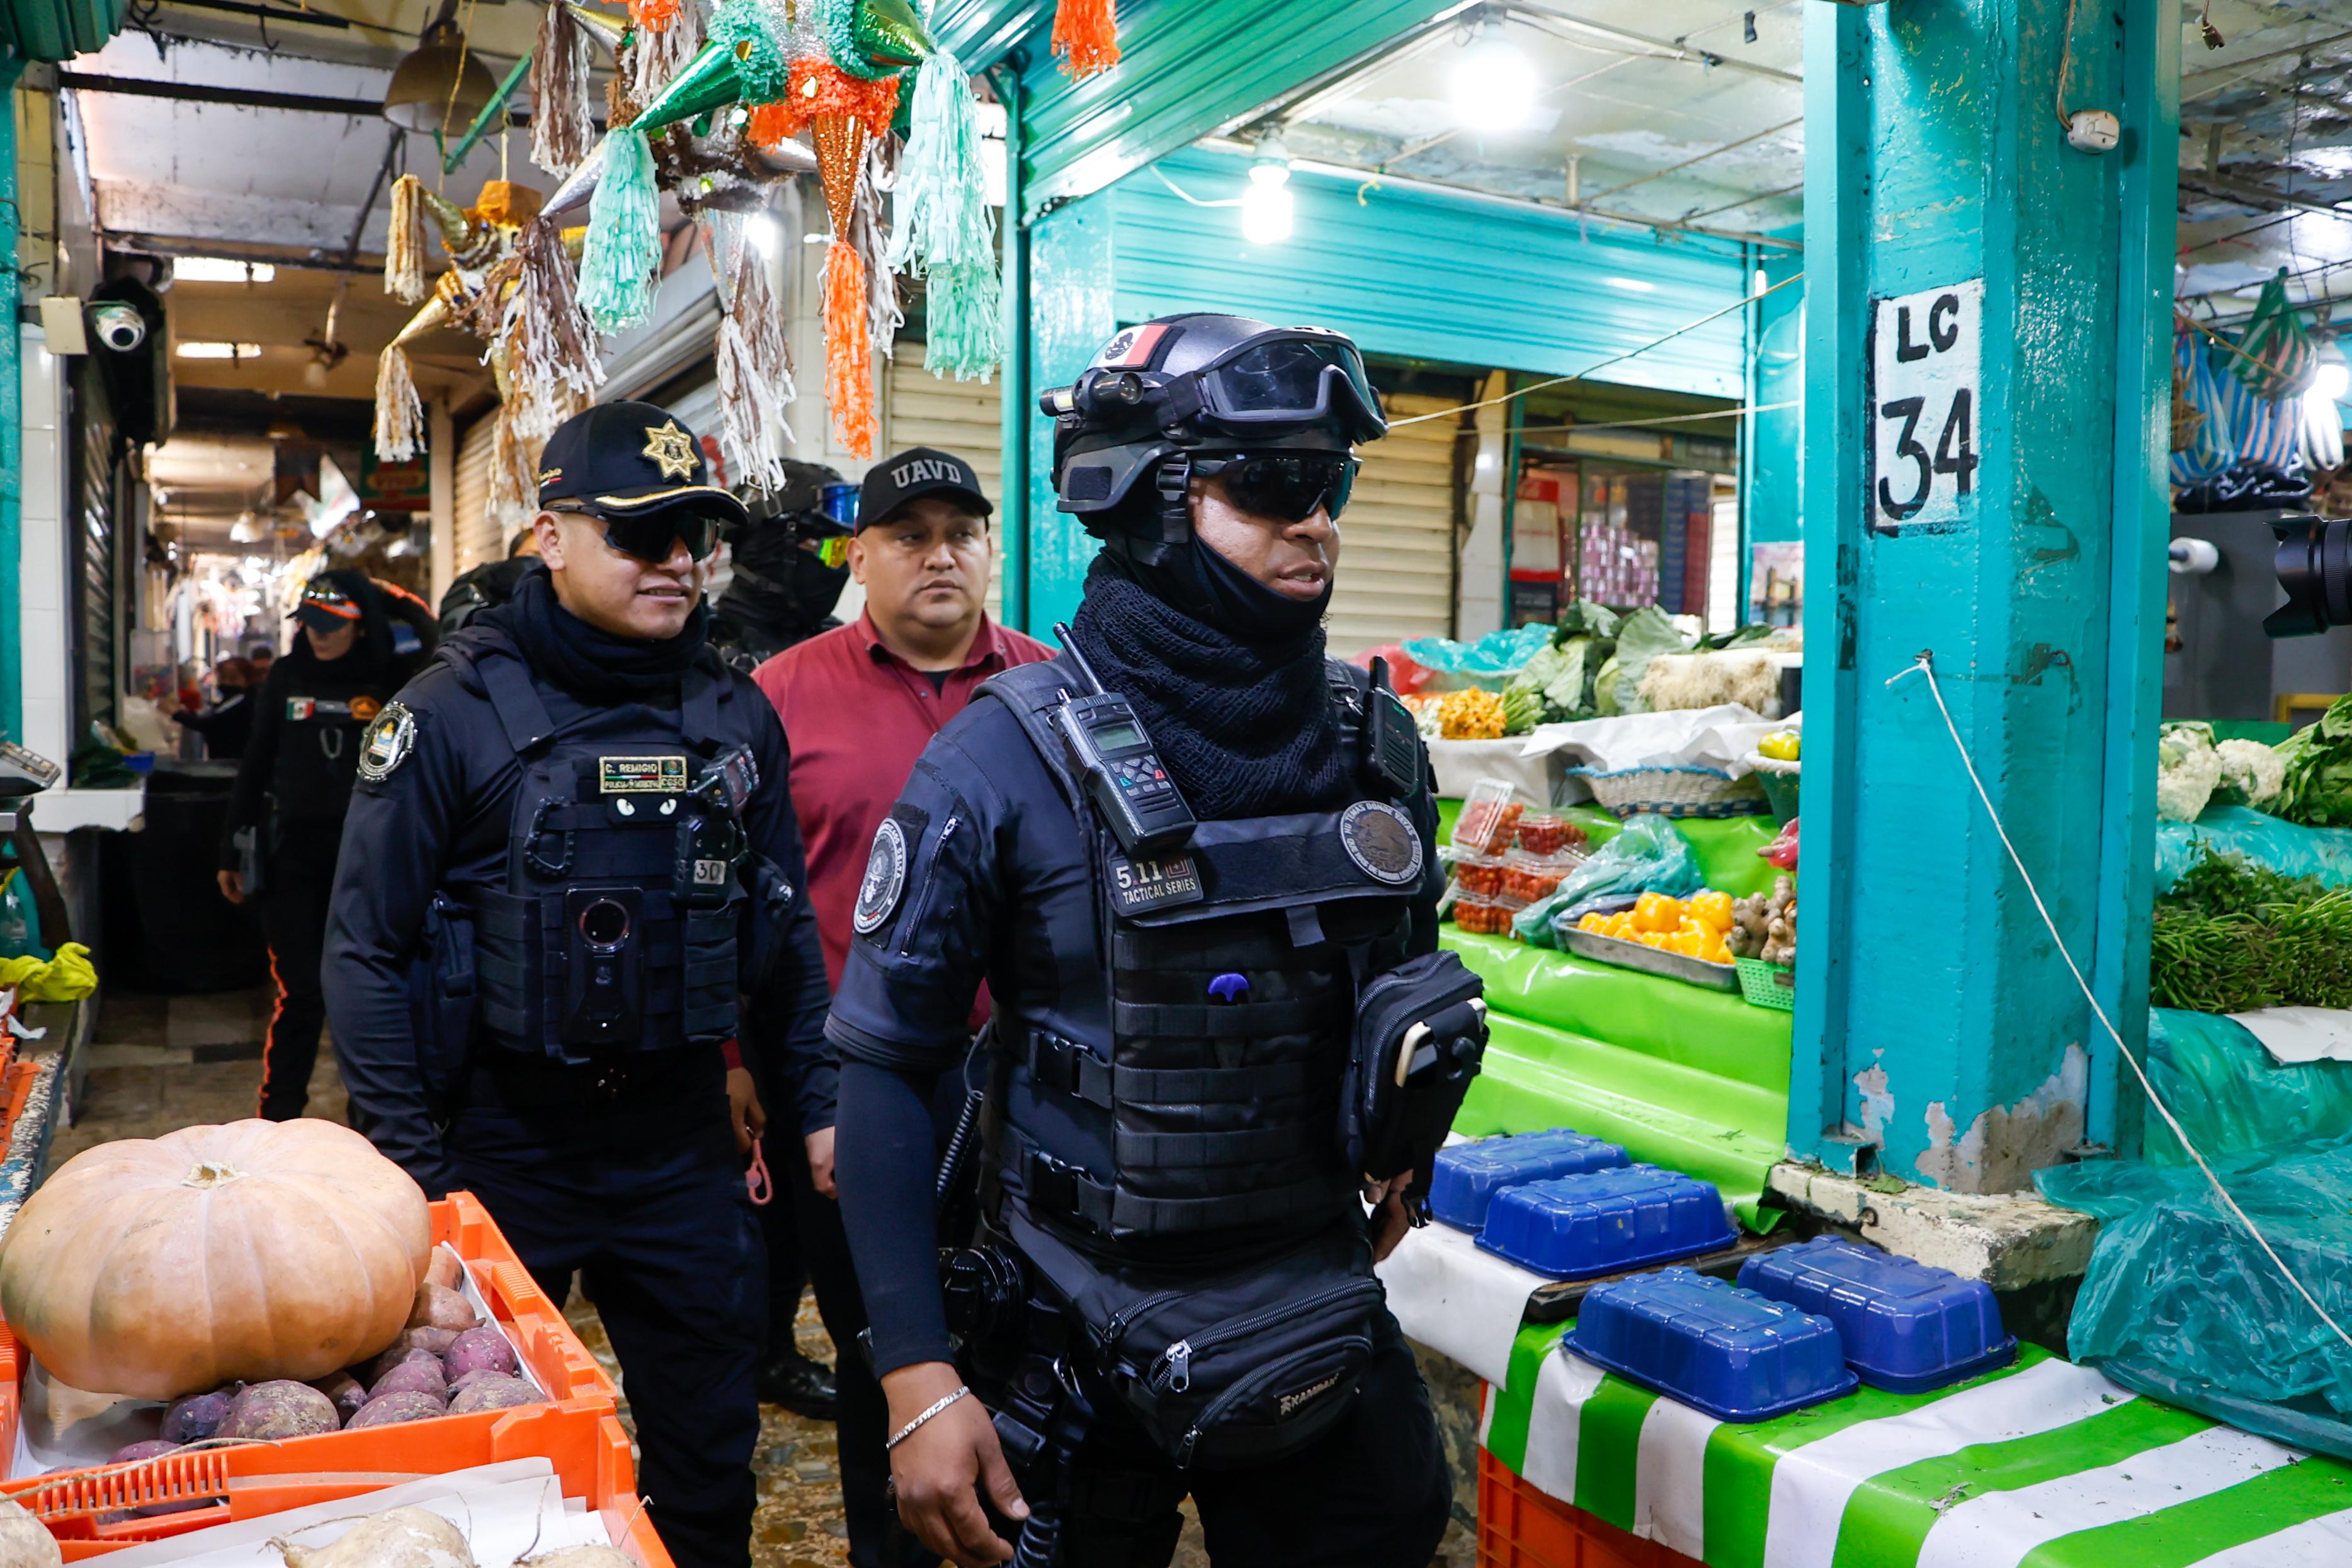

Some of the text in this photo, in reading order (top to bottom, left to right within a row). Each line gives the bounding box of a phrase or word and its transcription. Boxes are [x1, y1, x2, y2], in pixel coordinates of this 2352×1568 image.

[1897, 293, 1958, 363] LC
[1879, 387, 1979, 521] 34
[890, 458, 962, 488] UAVD
[619, 763, 657, 774] REMIGIO
[1344, 804, 1366, 822] TEMAS
[1366, 802, 1394, 815] DONDE
[1395, 812, 1412, 836] VAYAS
[696, 862, 721, 880] 30
[1116, 860, 1163, 889] 5.11
[1122, 878, 1196, 905] TACTICAL SERIES
